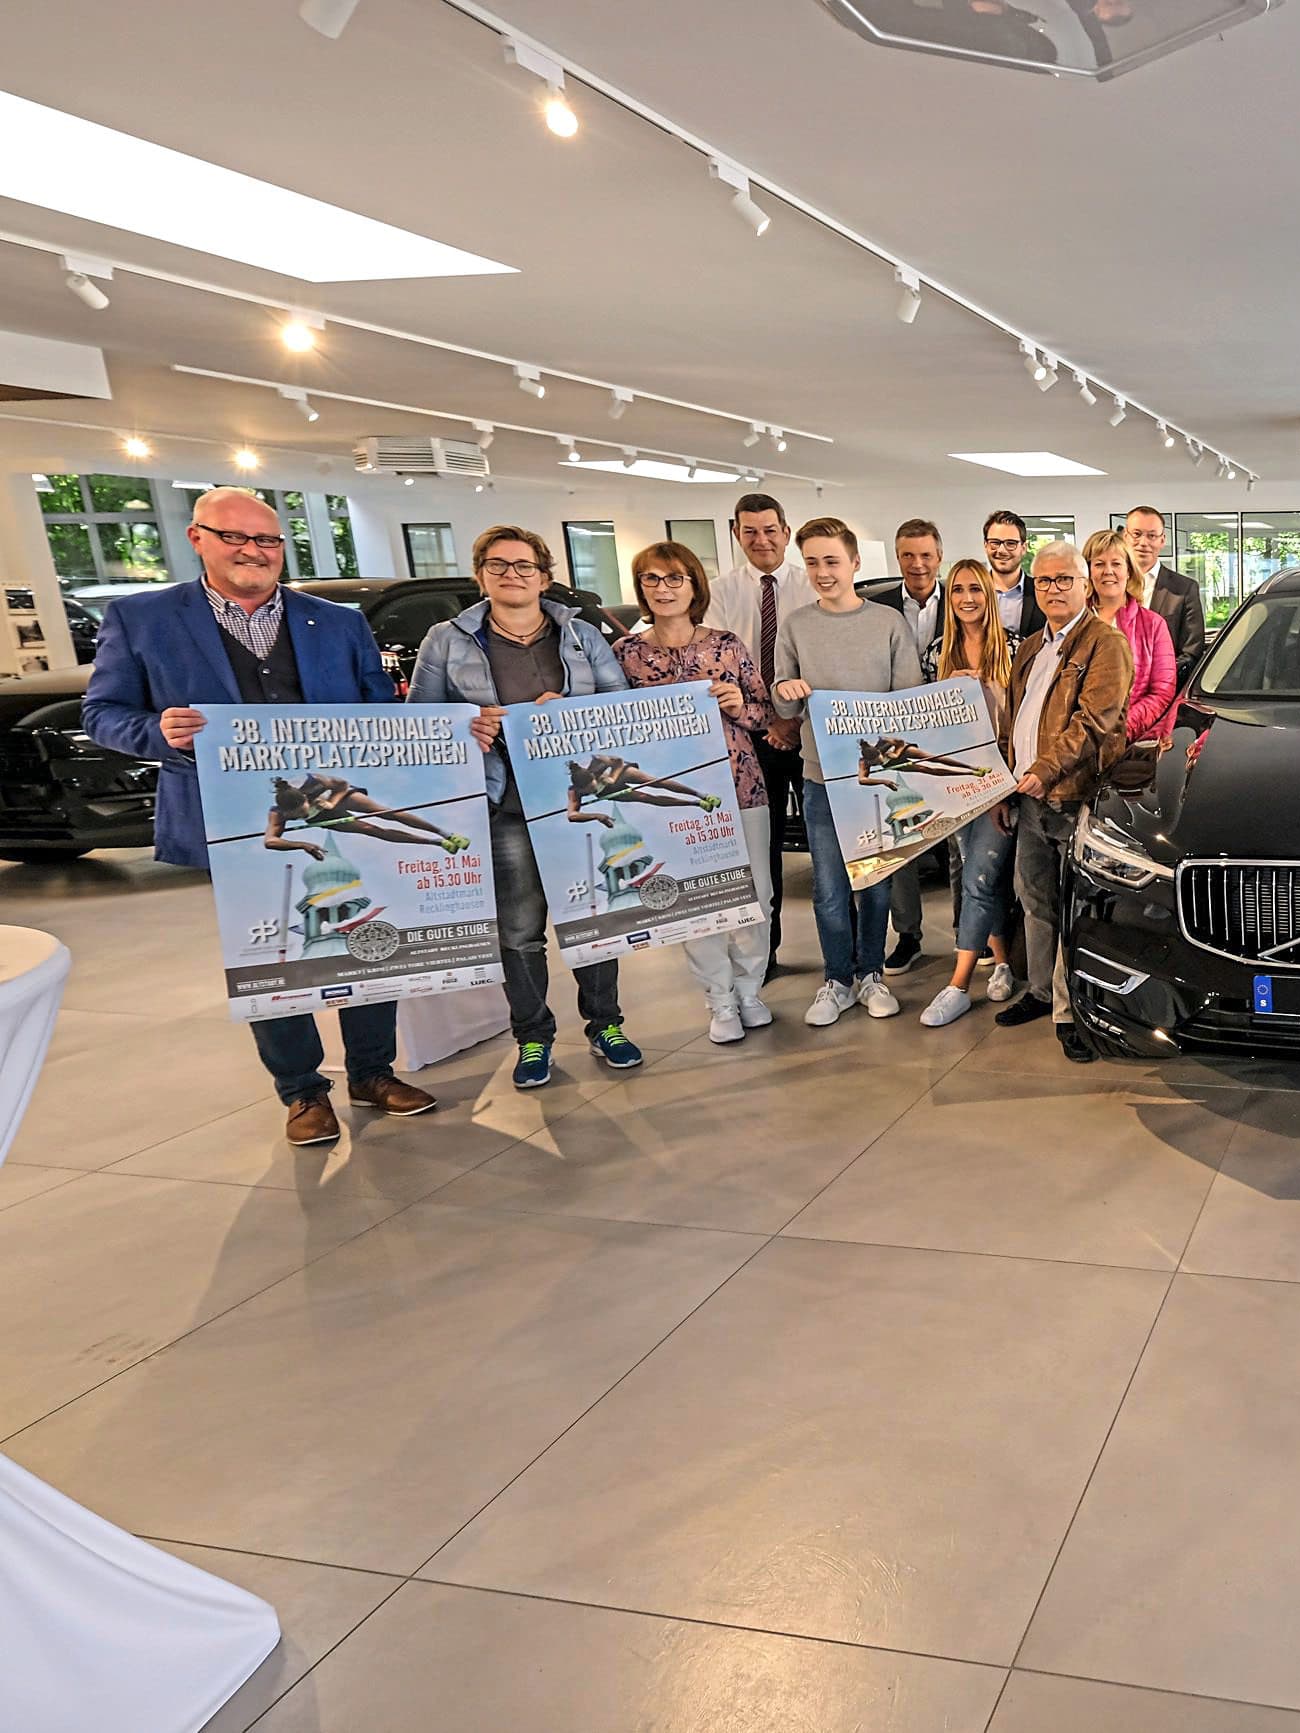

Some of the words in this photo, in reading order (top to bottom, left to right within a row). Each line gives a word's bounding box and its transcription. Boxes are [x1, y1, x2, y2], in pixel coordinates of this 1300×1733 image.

[831, 700, 853, 717] 38.
[853, 687, 965, 717] INTERNATIONALES
[529, 713, 558, 736] 38.
[559, 694, 696, 732] INTERNATIONALES
[825, 704, 978, 735] MARKTPLATZSPRINGEN
[231, 718, 267, 744] 38.
[271, 716, 452, 743] INTERNATIONALES
[523, 714, 711, 760] MARKTPLATZSPRINGEN
[219, 741, 467, 771] MARKTPLATZSPRINGEN
[717, 811, 733, 824] Mai
[685, 834, 696, 845] ab
[721, 827, 735, 838] Uhr
[398, 859, 442, 875] Freitag,
[444, 857, 459, 870] 31.
[462, 855, 481, 869] Mai
[417, 876, 430, 890] ab
[434, 874, 461, 888] 15.30
[464, 872, 481, 885] Uhr
[683, 881, 697, 891] DIE
[698, 876, 719, 887] GUTE
[721, 869, 746, 881] STUBE
[407, 929, 424, 943] DIE
[427, 926, 454, 940] GUTE
[457, 923, 490, 937] STUBE
[1260, 999, 1267, 1007] S
